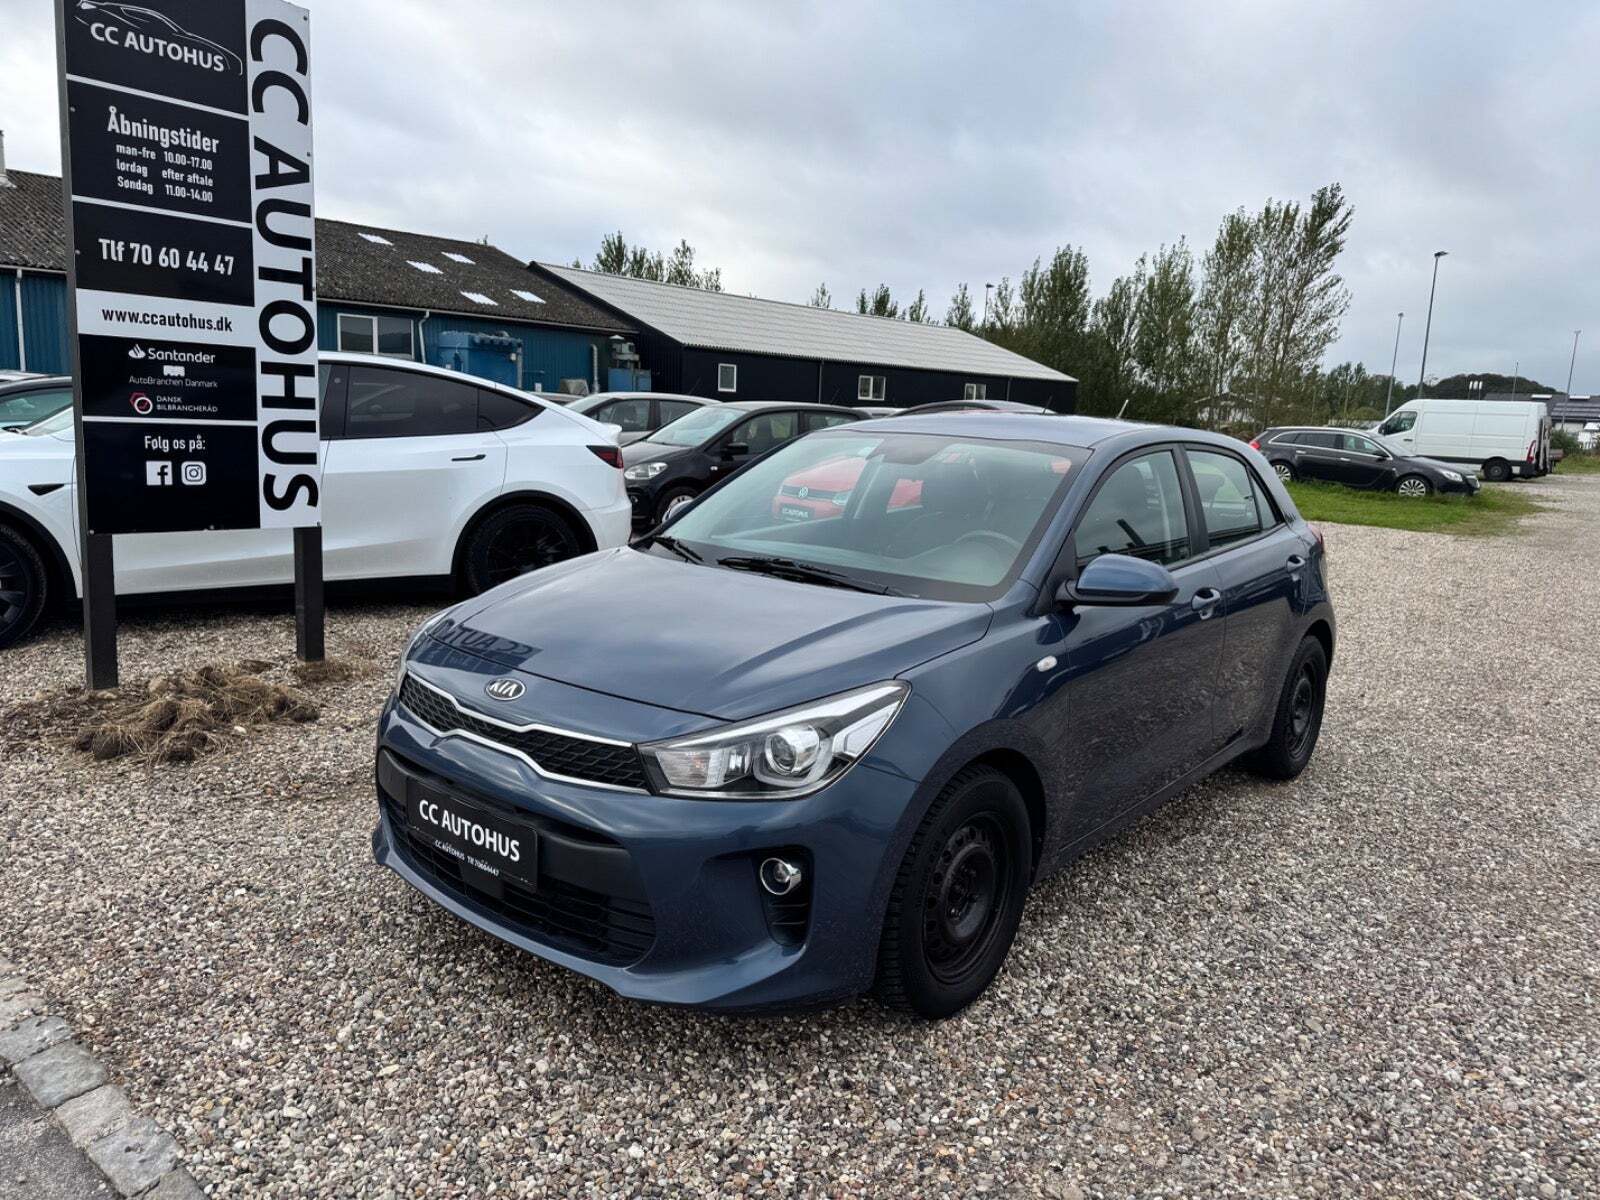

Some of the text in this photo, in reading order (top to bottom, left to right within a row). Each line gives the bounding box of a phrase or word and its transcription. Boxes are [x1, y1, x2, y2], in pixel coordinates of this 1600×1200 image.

[90, 22, 224, 72] CC AUTOHUS
[107, 105, 219, 153] Åbningstider
[116, 144, 213, 171] man-fre 10.00-17.00
[117, 175, 213, 203] Søndag 11.00-14.00
[162, 168, 185, 182] efter
[187, 173, 213, 187] aftale
[98, 238, 235, 276] Tlf 70 60 44 47
[250, 18, 319, 512] CC AUTOHUS
[102, 308, 233, 333] www.ccautohus.dk
[148, 347, 216, 364] Santander
[185, 378, 219, 389] Danmark
[156, 395, 182, 403] DANSK
[144, 433, 206, 453] Følg os på:
[420, 799, 520, 862] CC AUTOHUS
